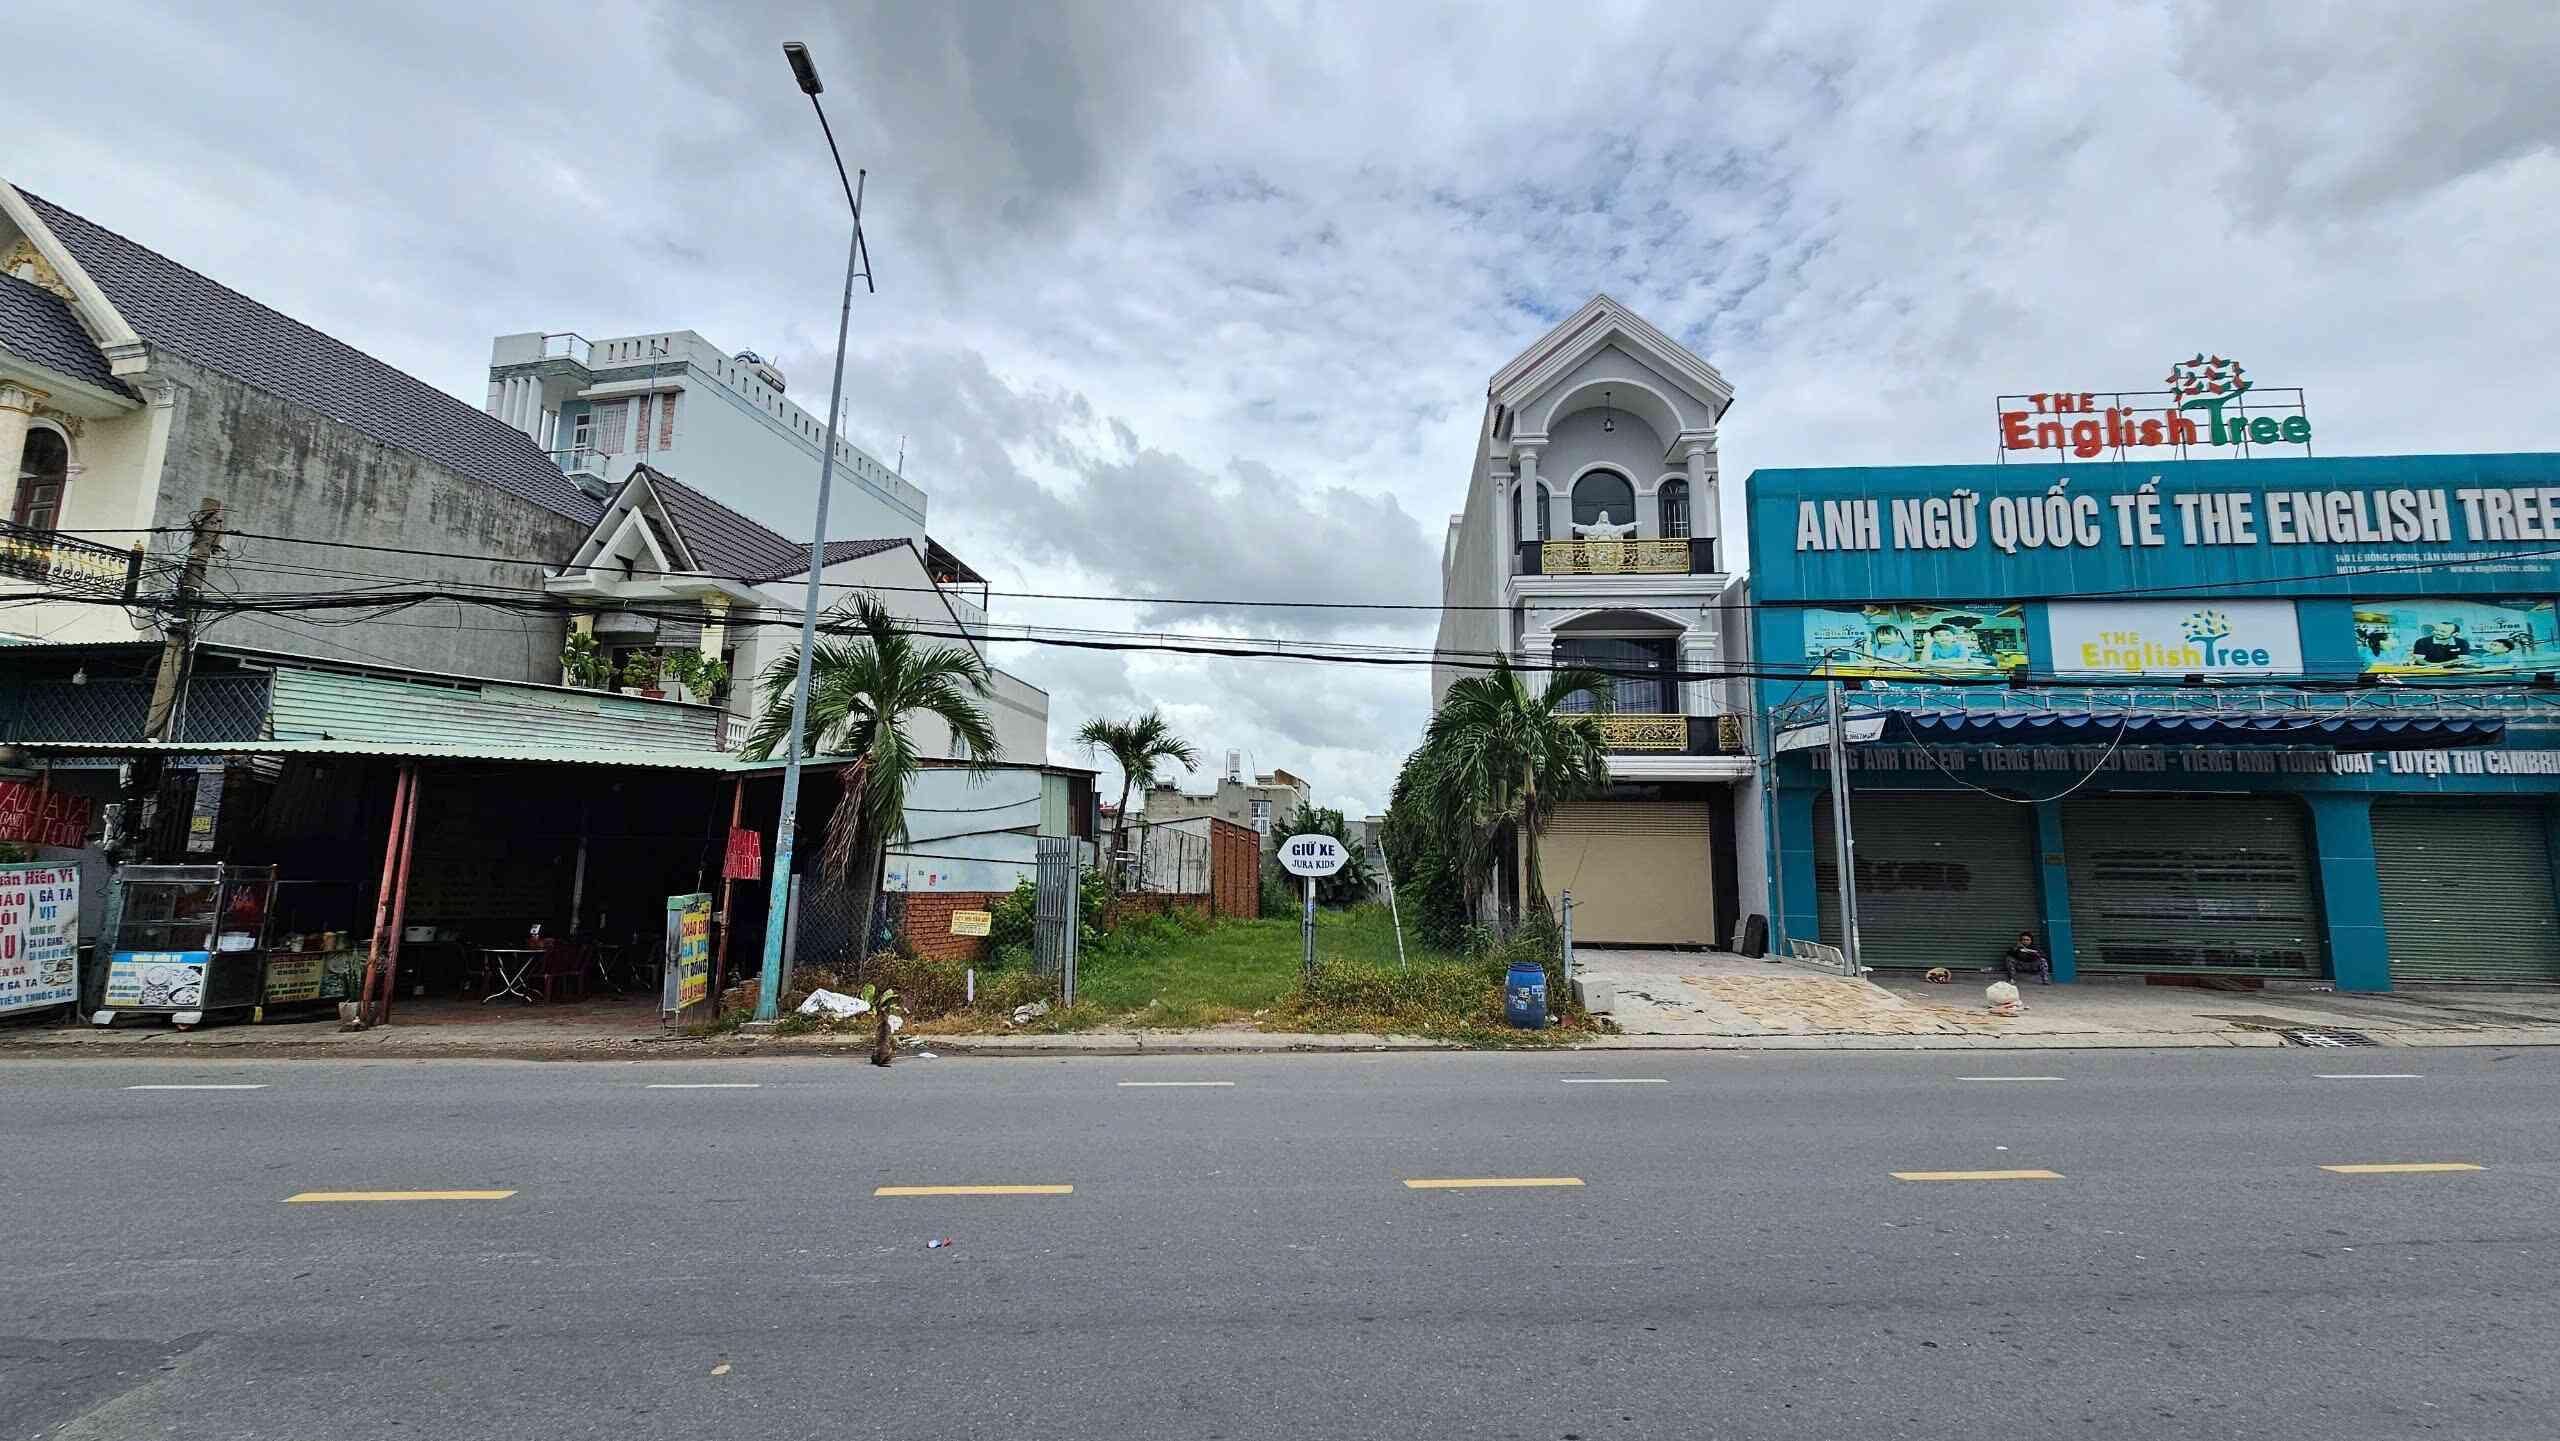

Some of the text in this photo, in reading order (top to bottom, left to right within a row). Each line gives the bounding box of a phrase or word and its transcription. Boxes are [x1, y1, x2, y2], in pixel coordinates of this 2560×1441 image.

[2028, 392, 2096, 414] THE
[1797, 475, 2560, 555] ANH NGỮ QUỐC TẾ THE ENGLISH TREE
[2099, 631, 2140, 645] THE
[2451, 750, 2484, 775] THI
[1292, 841, 1335, 856] GIỮ XE
[1292, 859, 1336, 869] JURA KIDS
[57, 888, 73, 901] TA
